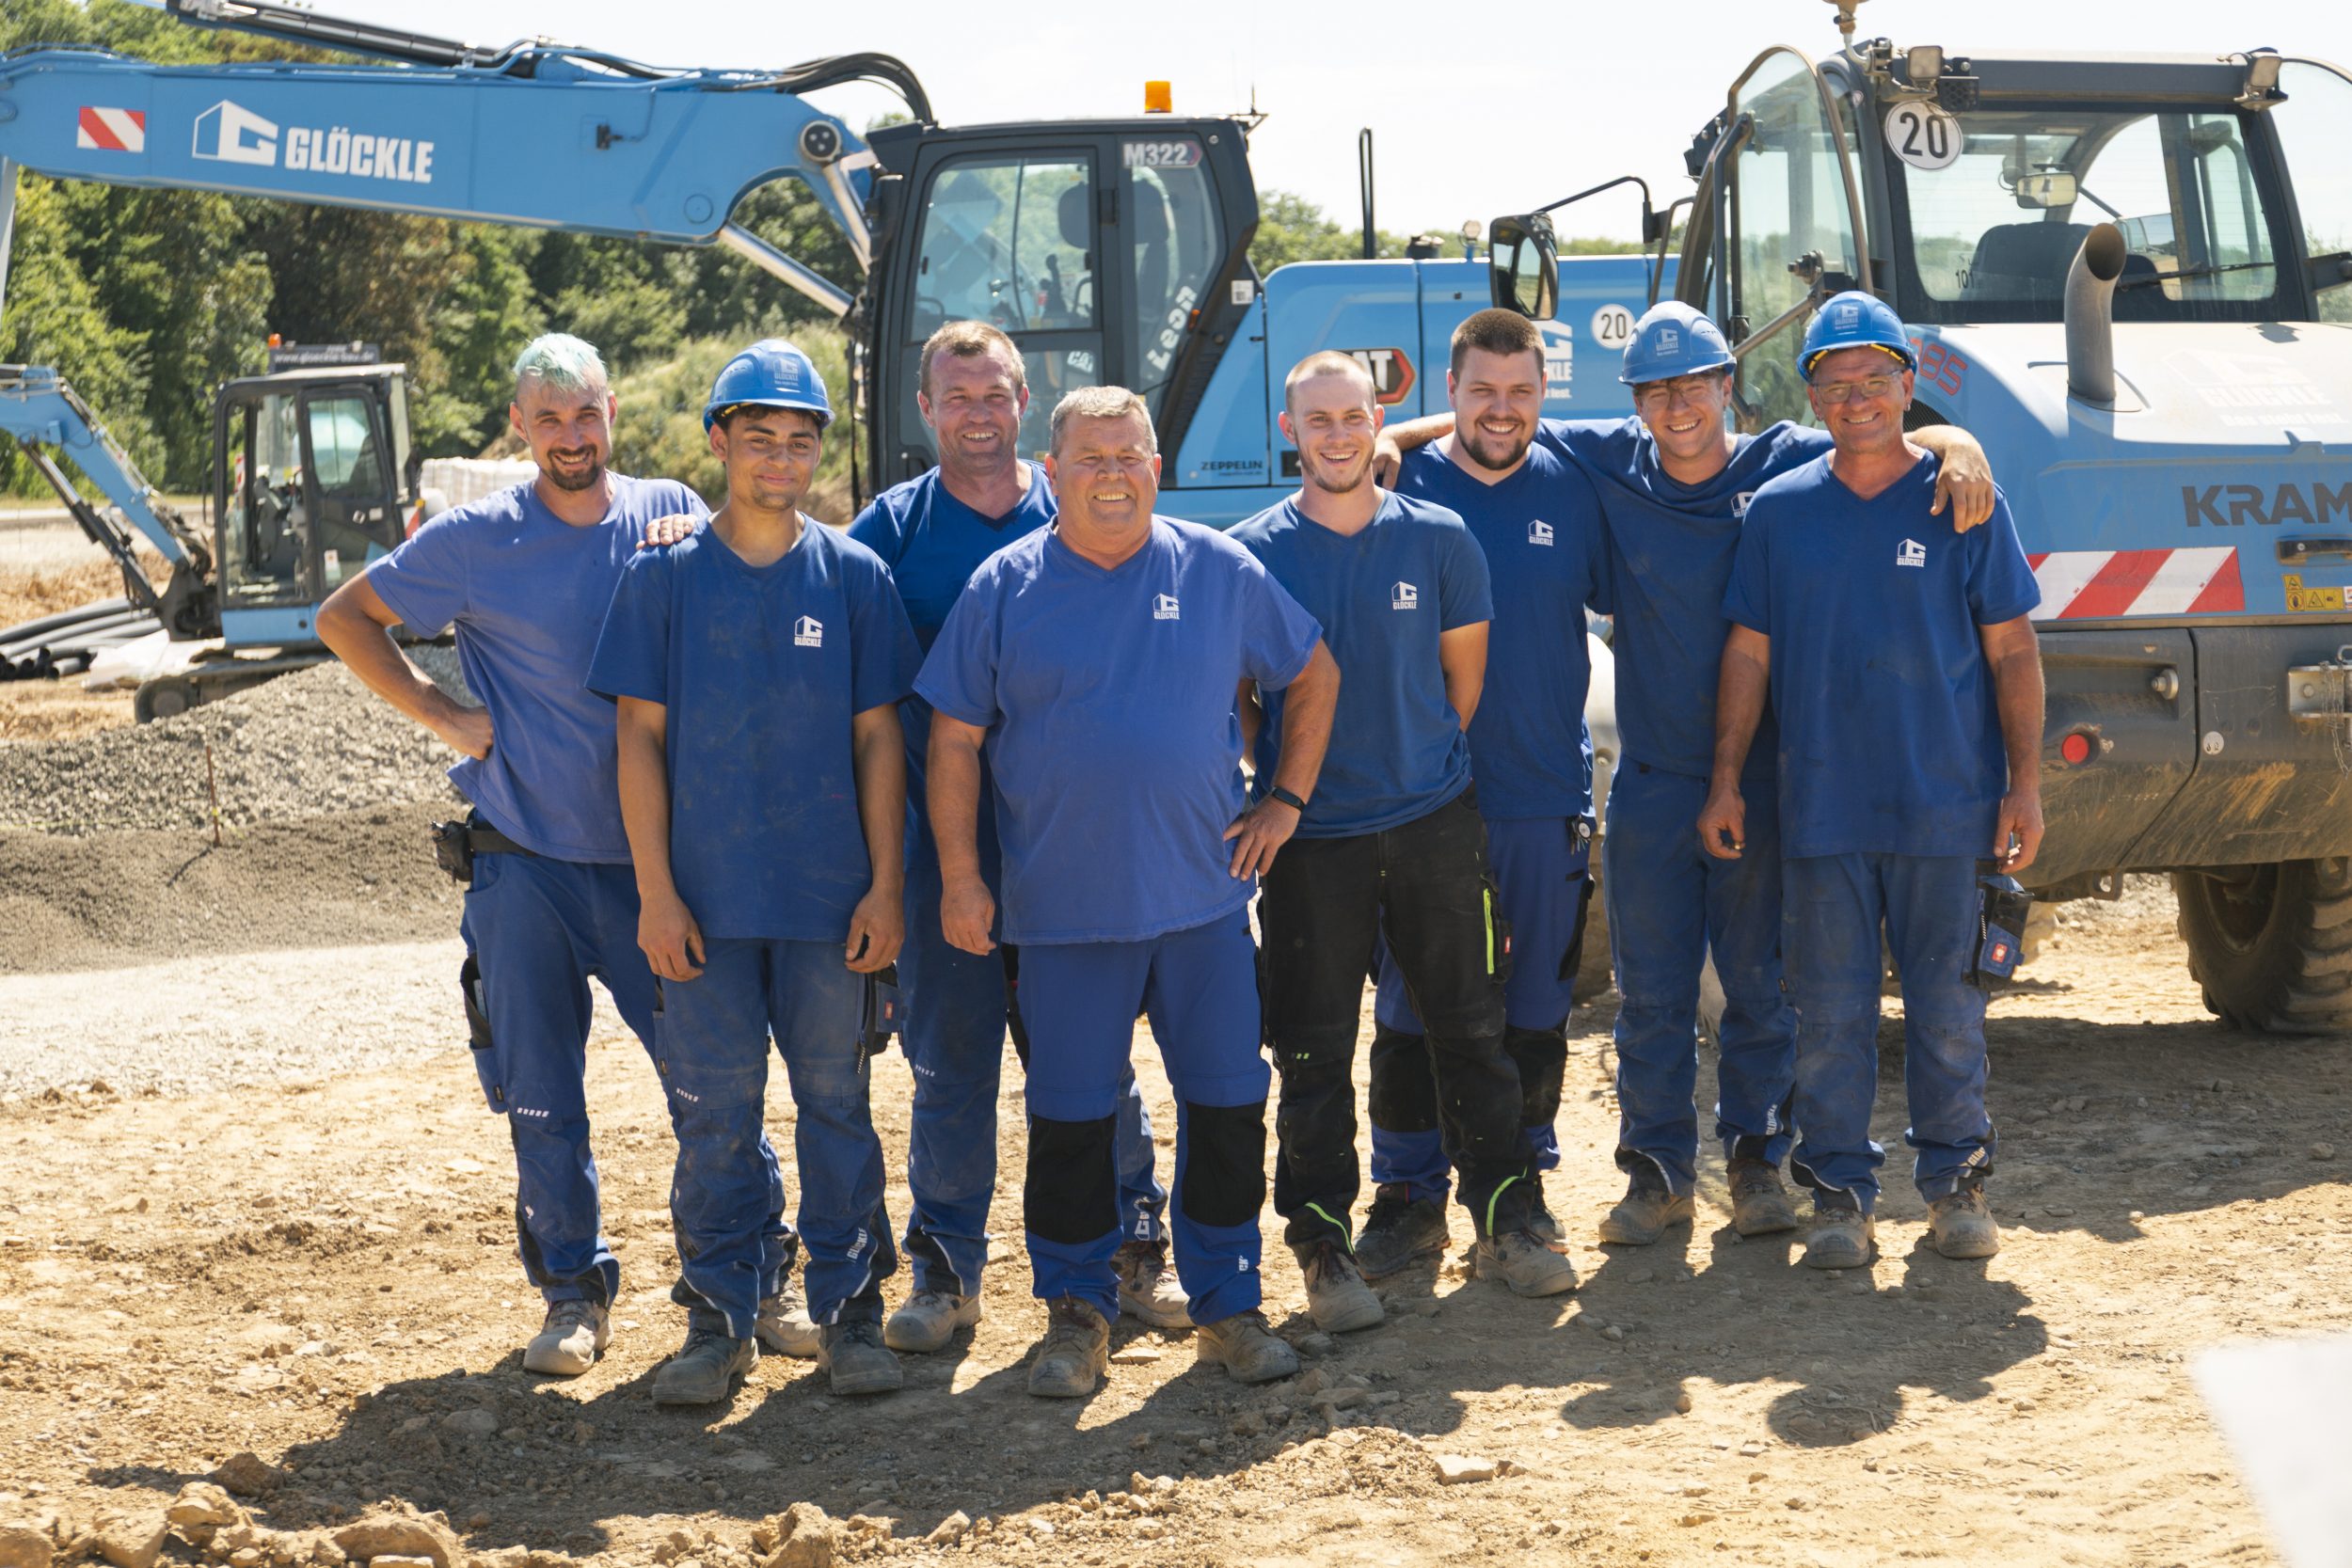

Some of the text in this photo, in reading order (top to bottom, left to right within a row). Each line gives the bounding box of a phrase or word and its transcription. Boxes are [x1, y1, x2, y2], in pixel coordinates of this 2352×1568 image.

[1899, 111, 1948, 159] 20
[284, 125, 435, 183] GLÖCKLE
[1123, 143, 1188, 166] M322
[1146, 285, 1198, 372] Leon
[1601, 313, 1627, 340] 20
[1200, 460, 1263, 470] ZEPPELIN
